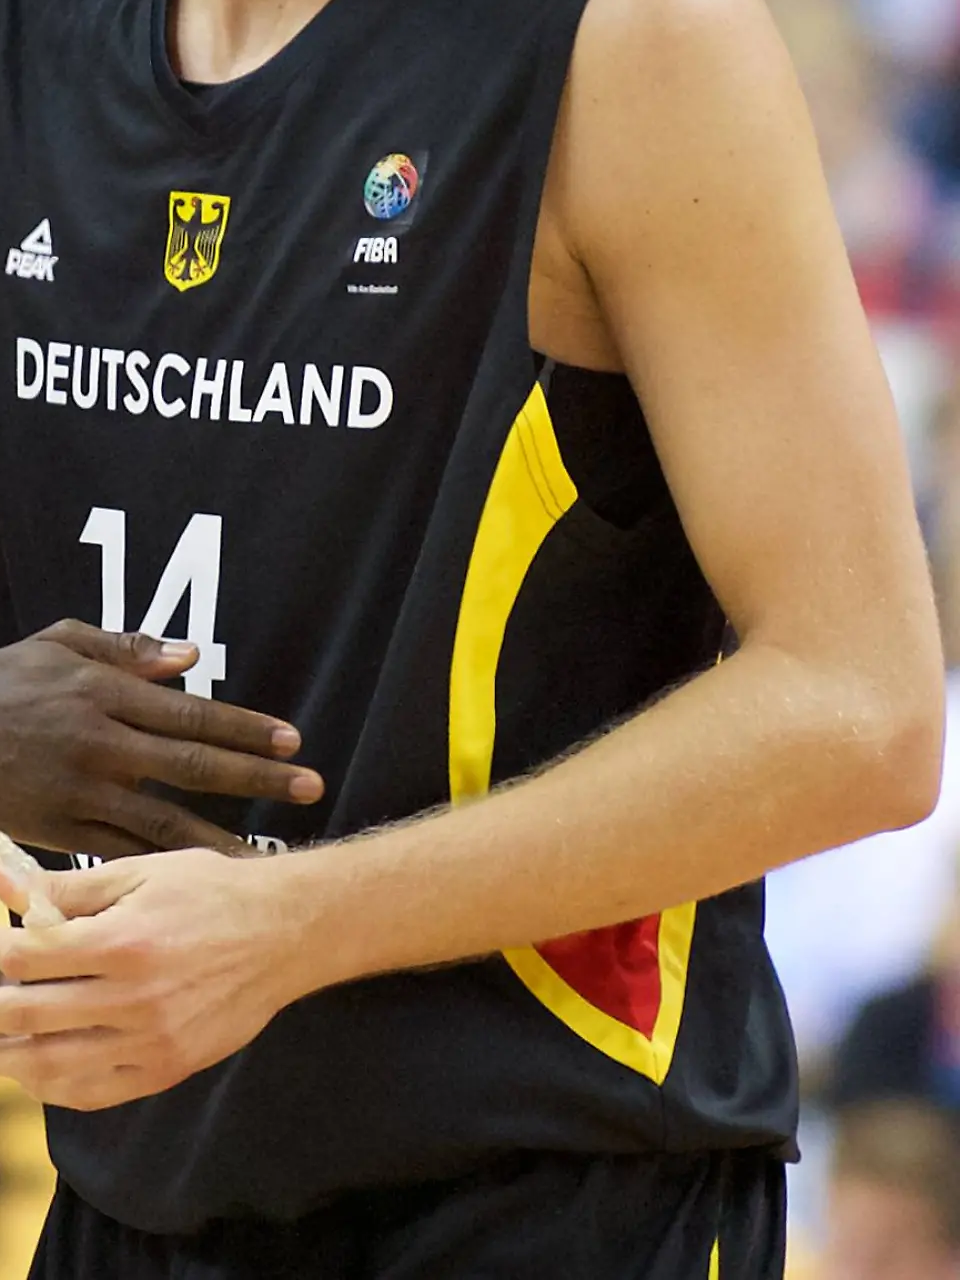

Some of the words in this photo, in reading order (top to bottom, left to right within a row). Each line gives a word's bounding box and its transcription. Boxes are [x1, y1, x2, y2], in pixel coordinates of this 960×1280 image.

[5, 248, 59, 282] PEAK
[353, 236, 398, 264] FIBA
[16, 337, 394, 429] DEUTSCHLAND
[79, 507, 227, 700] 14
